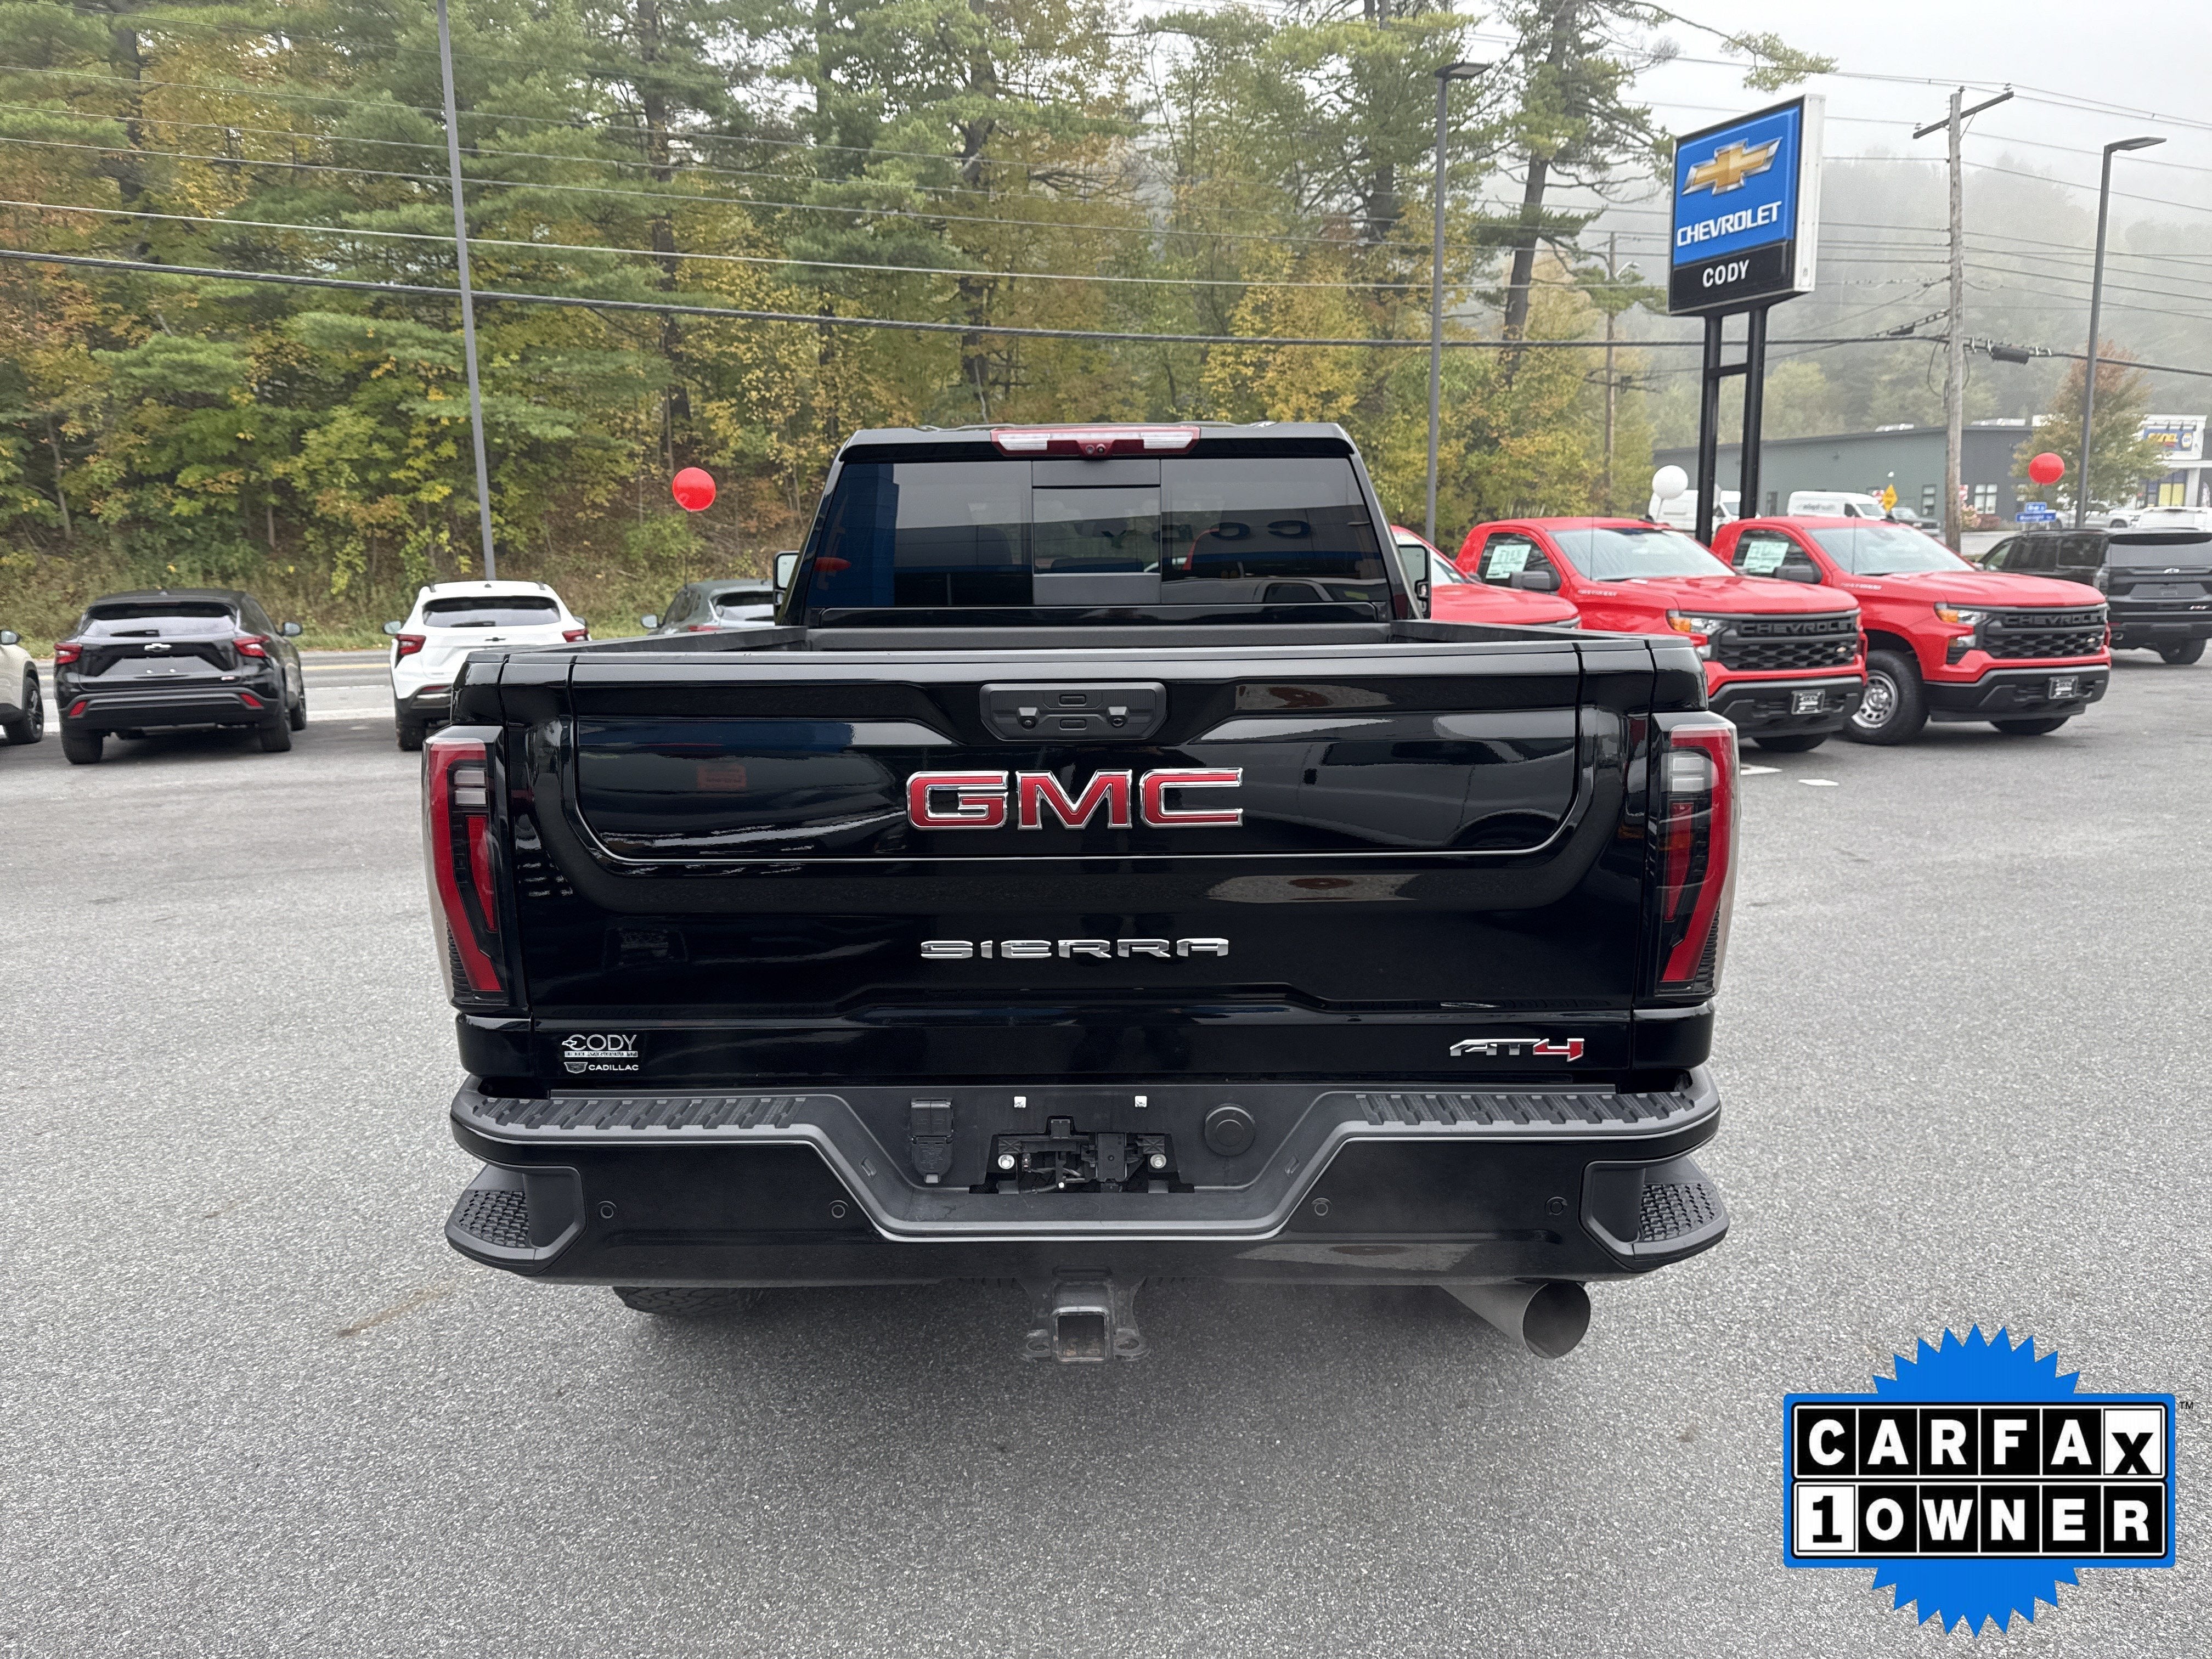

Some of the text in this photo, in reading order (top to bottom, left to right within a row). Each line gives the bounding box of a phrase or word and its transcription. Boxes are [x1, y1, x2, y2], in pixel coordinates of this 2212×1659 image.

[1676, 201, 1782, 247] CHEVROLET
[1702, 259, 1750, 287] CODY
[906, 768, 1243, 830] GMC
[921, 938, 1229, 959] SIERRA
[565, 1034, 637, 1050] CODY
[1450, 1038, 1584, 1062] AT4
